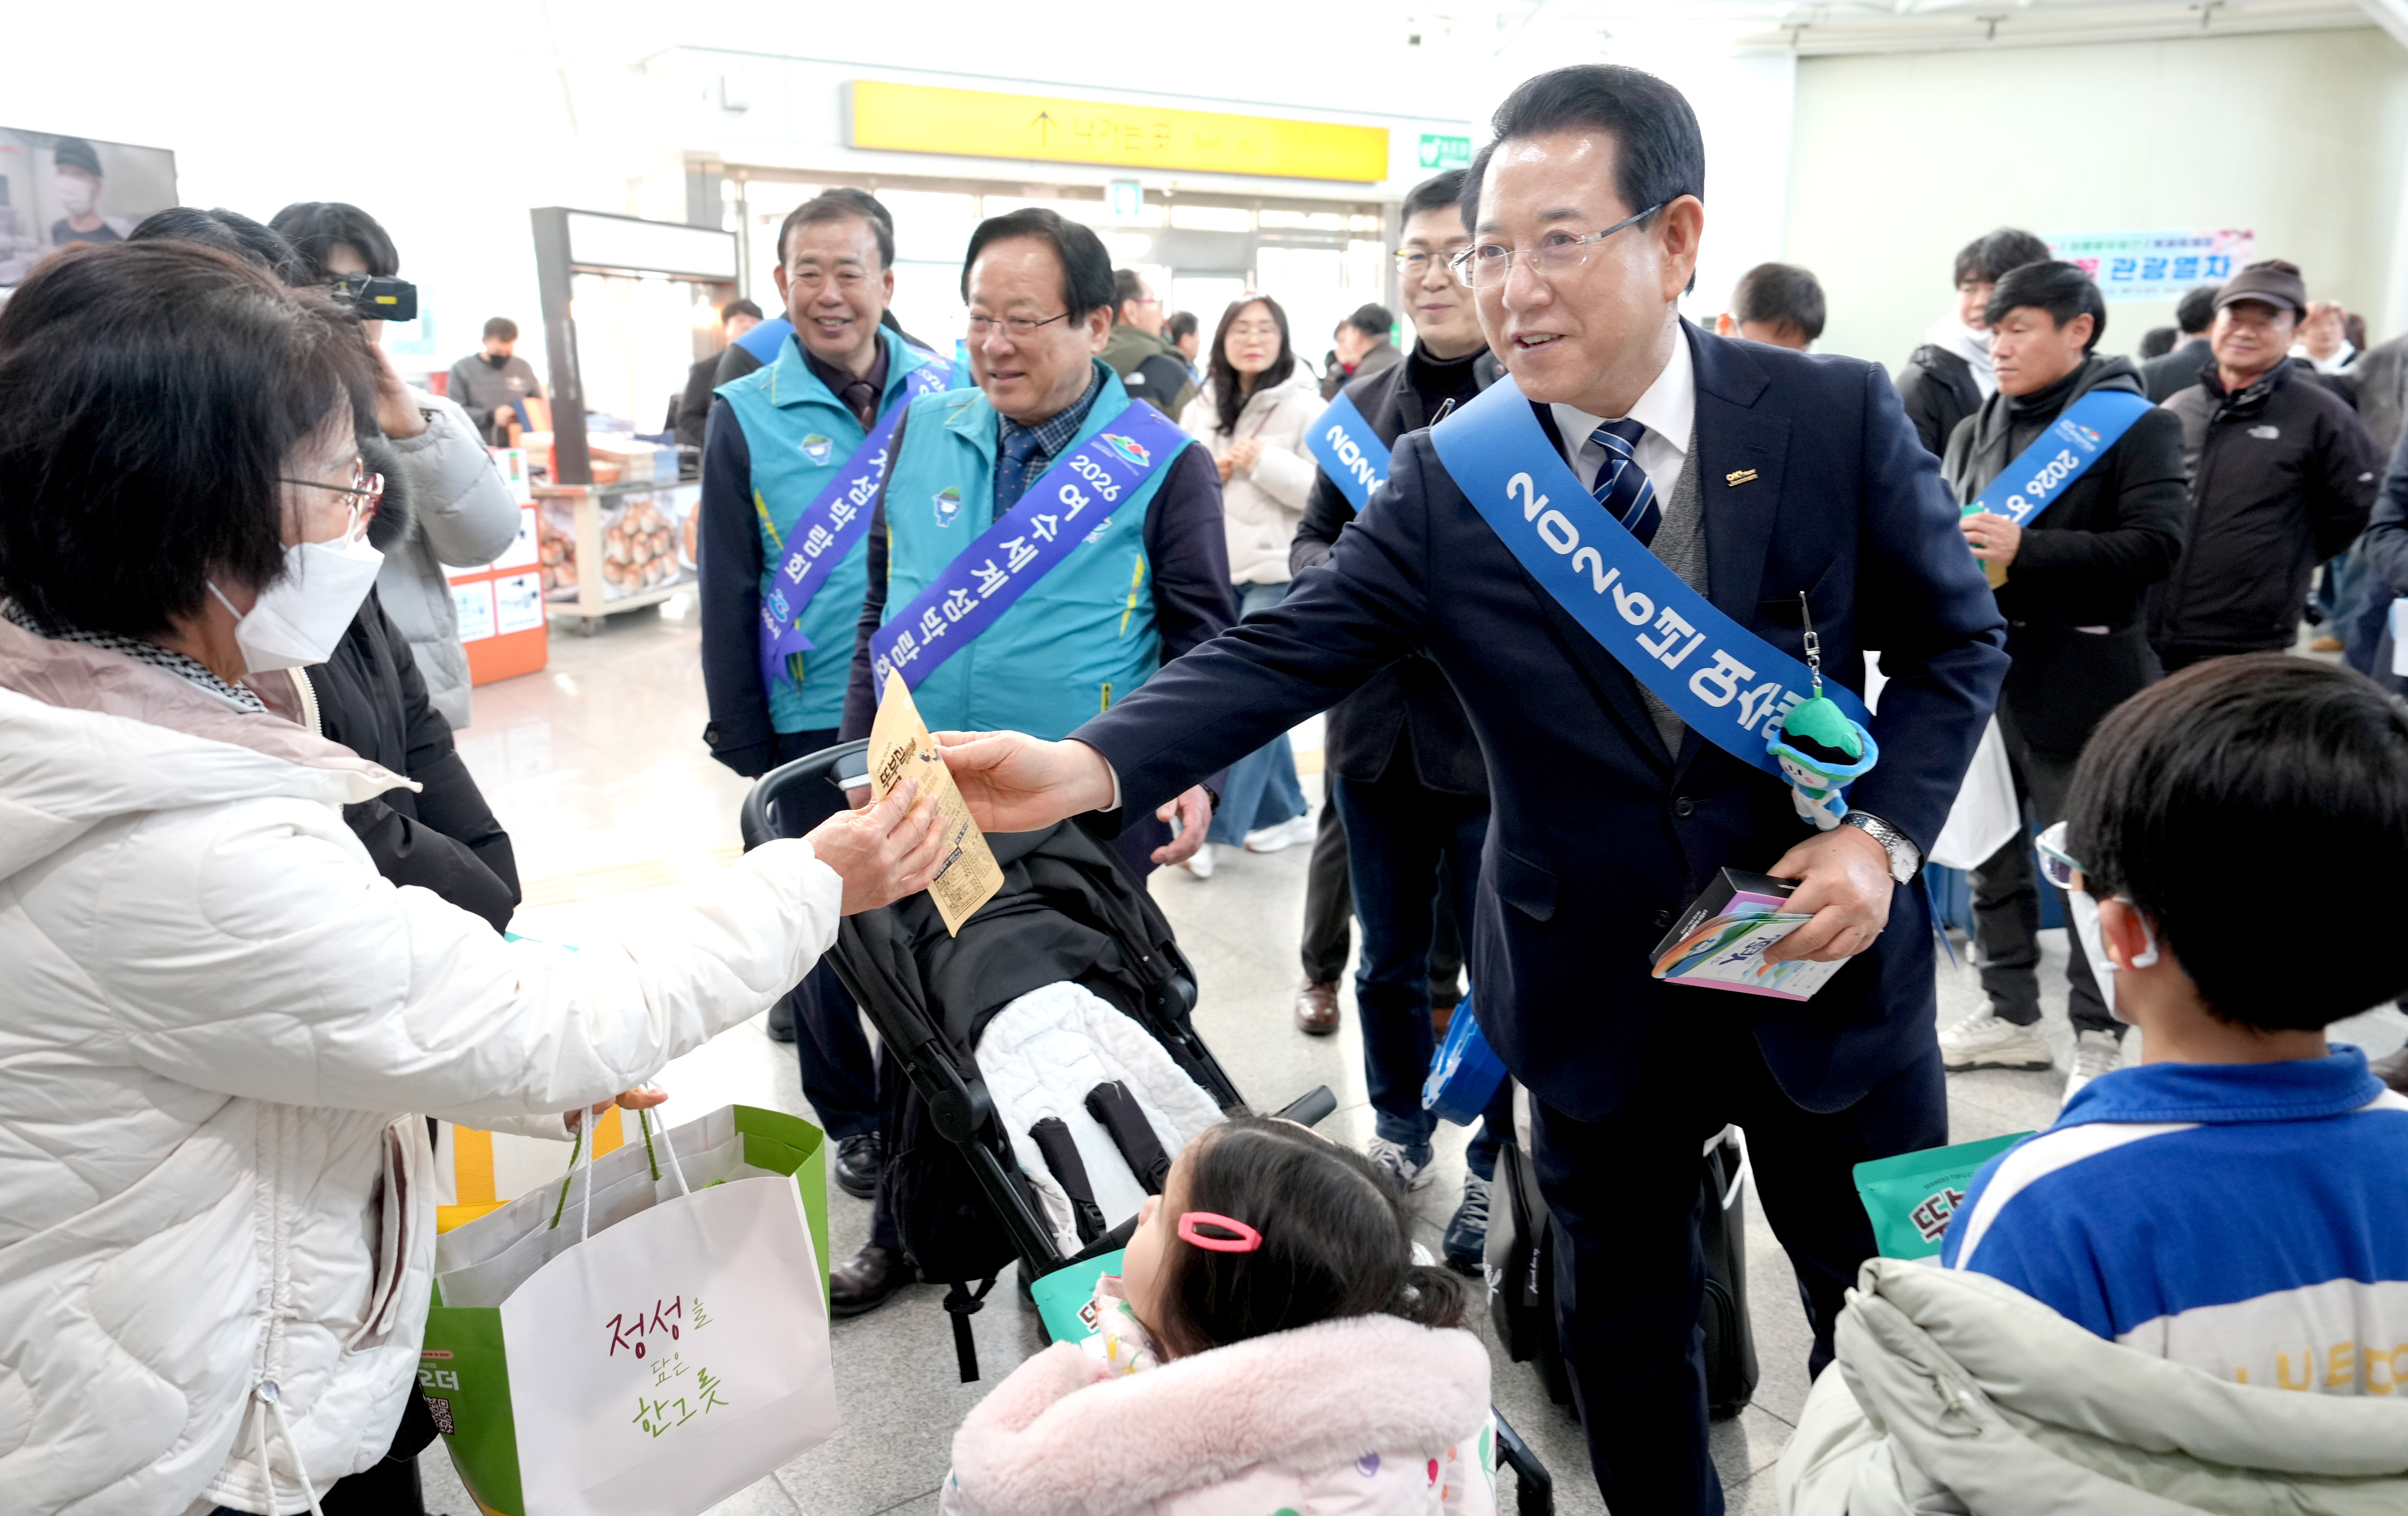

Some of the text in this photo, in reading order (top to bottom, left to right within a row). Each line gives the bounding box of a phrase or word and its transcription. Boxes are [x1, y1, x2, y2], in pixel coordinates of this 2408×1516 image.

[1073, 115, 1144, 152] 나가는
[1149, 122, 1172, 154] 곳
[1194, 131, 1223, 152] Exit
[2110, 255, 2232, 282] 관광열차
[1069, 455, 1122, 502] 2026
[1326, 425, 1385, 496] 2026
[2026, 448, 2079, 498] 2026
[1506, 472, 1707, 670] 2026년
[920, 766, 934, 783] AND
[925, 775, 939, 795] BEAN
[1913, 1189, 1964, 1239] 뚜
[605, 1296, 713, 1359] 정성을
[650, 1351, 690, 1387] 담은
[632, 1367, 729, 1438] 한그릇
